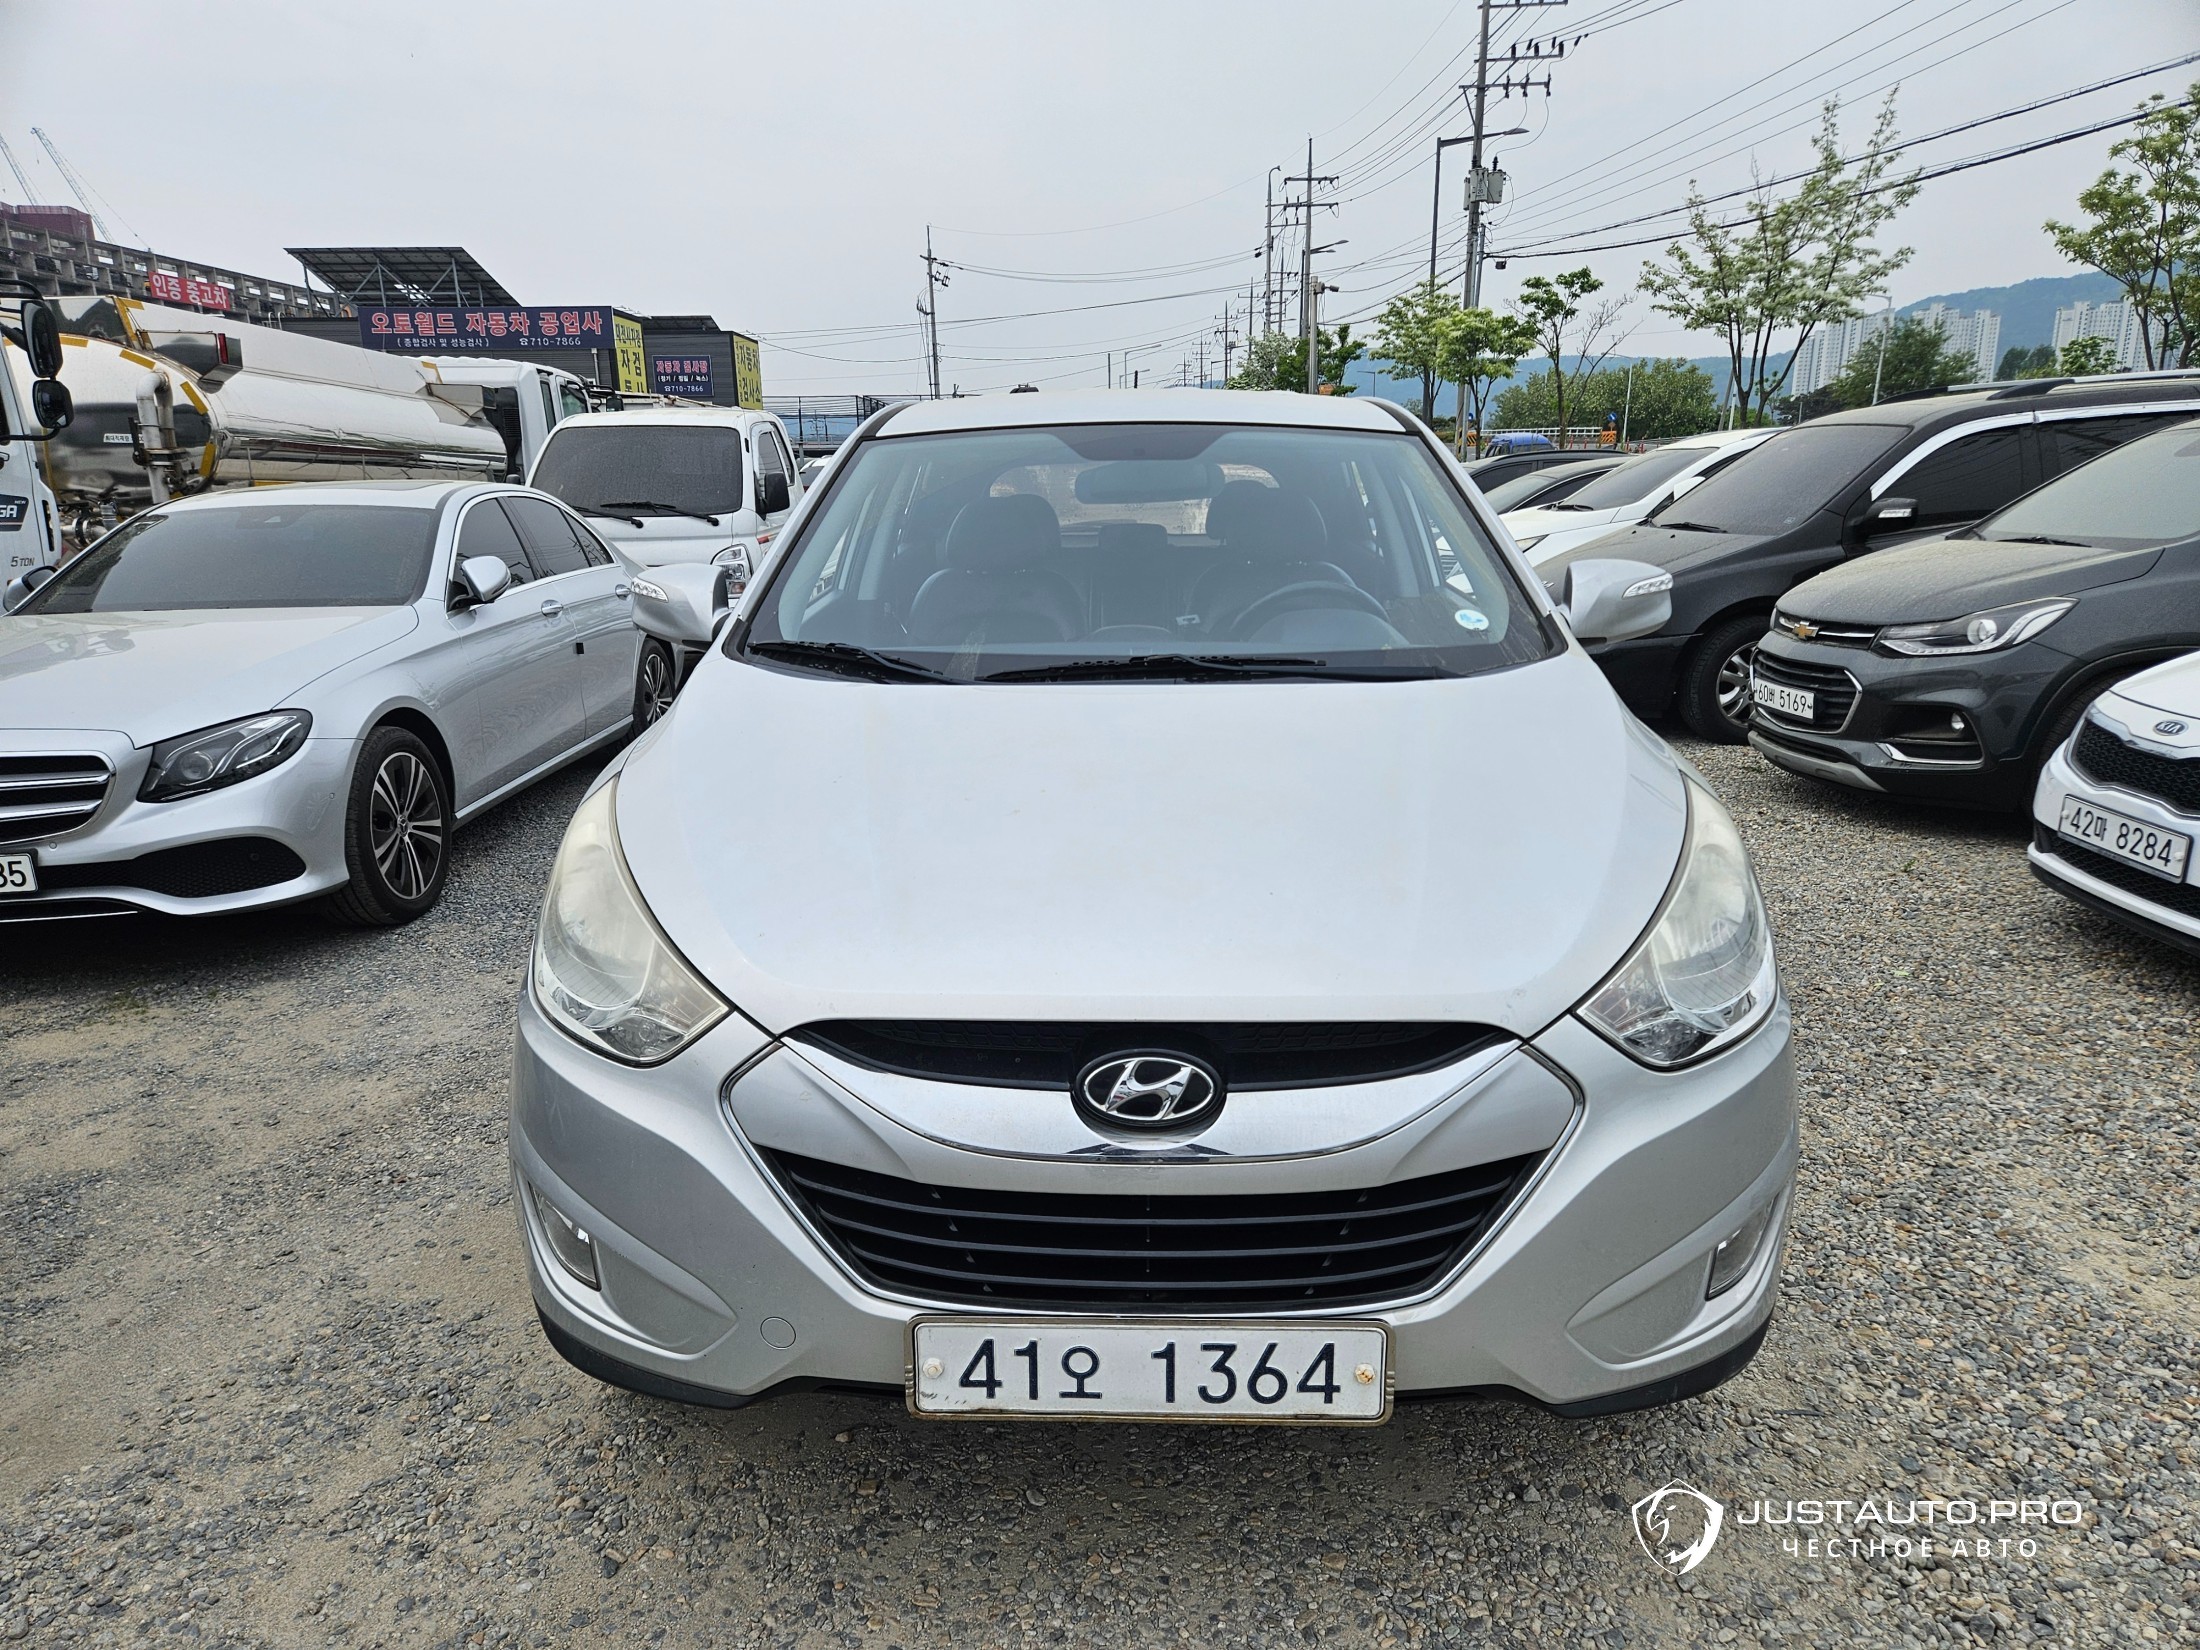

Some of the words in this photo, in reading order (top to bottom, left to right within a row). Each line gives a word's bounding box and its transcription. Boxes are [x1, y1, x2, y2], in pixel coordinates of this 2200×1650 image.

[152, 274, 181, 300] 인증
[187, 281, 227, 309] 중고차
[371, 311, 457, 336] 오토월드
[465, 312, 530, 336] 자동차
[538, 311, 602, 335] 공업사
[529, 337, 581, 346] 710-7866
[656, 360, 681, 373] 자동차
[1779, 689, 1807, 713] 5169
[2070, 807, 2108, 842] 42마
[2116, 822, 2172, 867] 8284
[959, 1338, 1102, 1401] 41오
[1150, 1341, 1341, 1404] 1364
